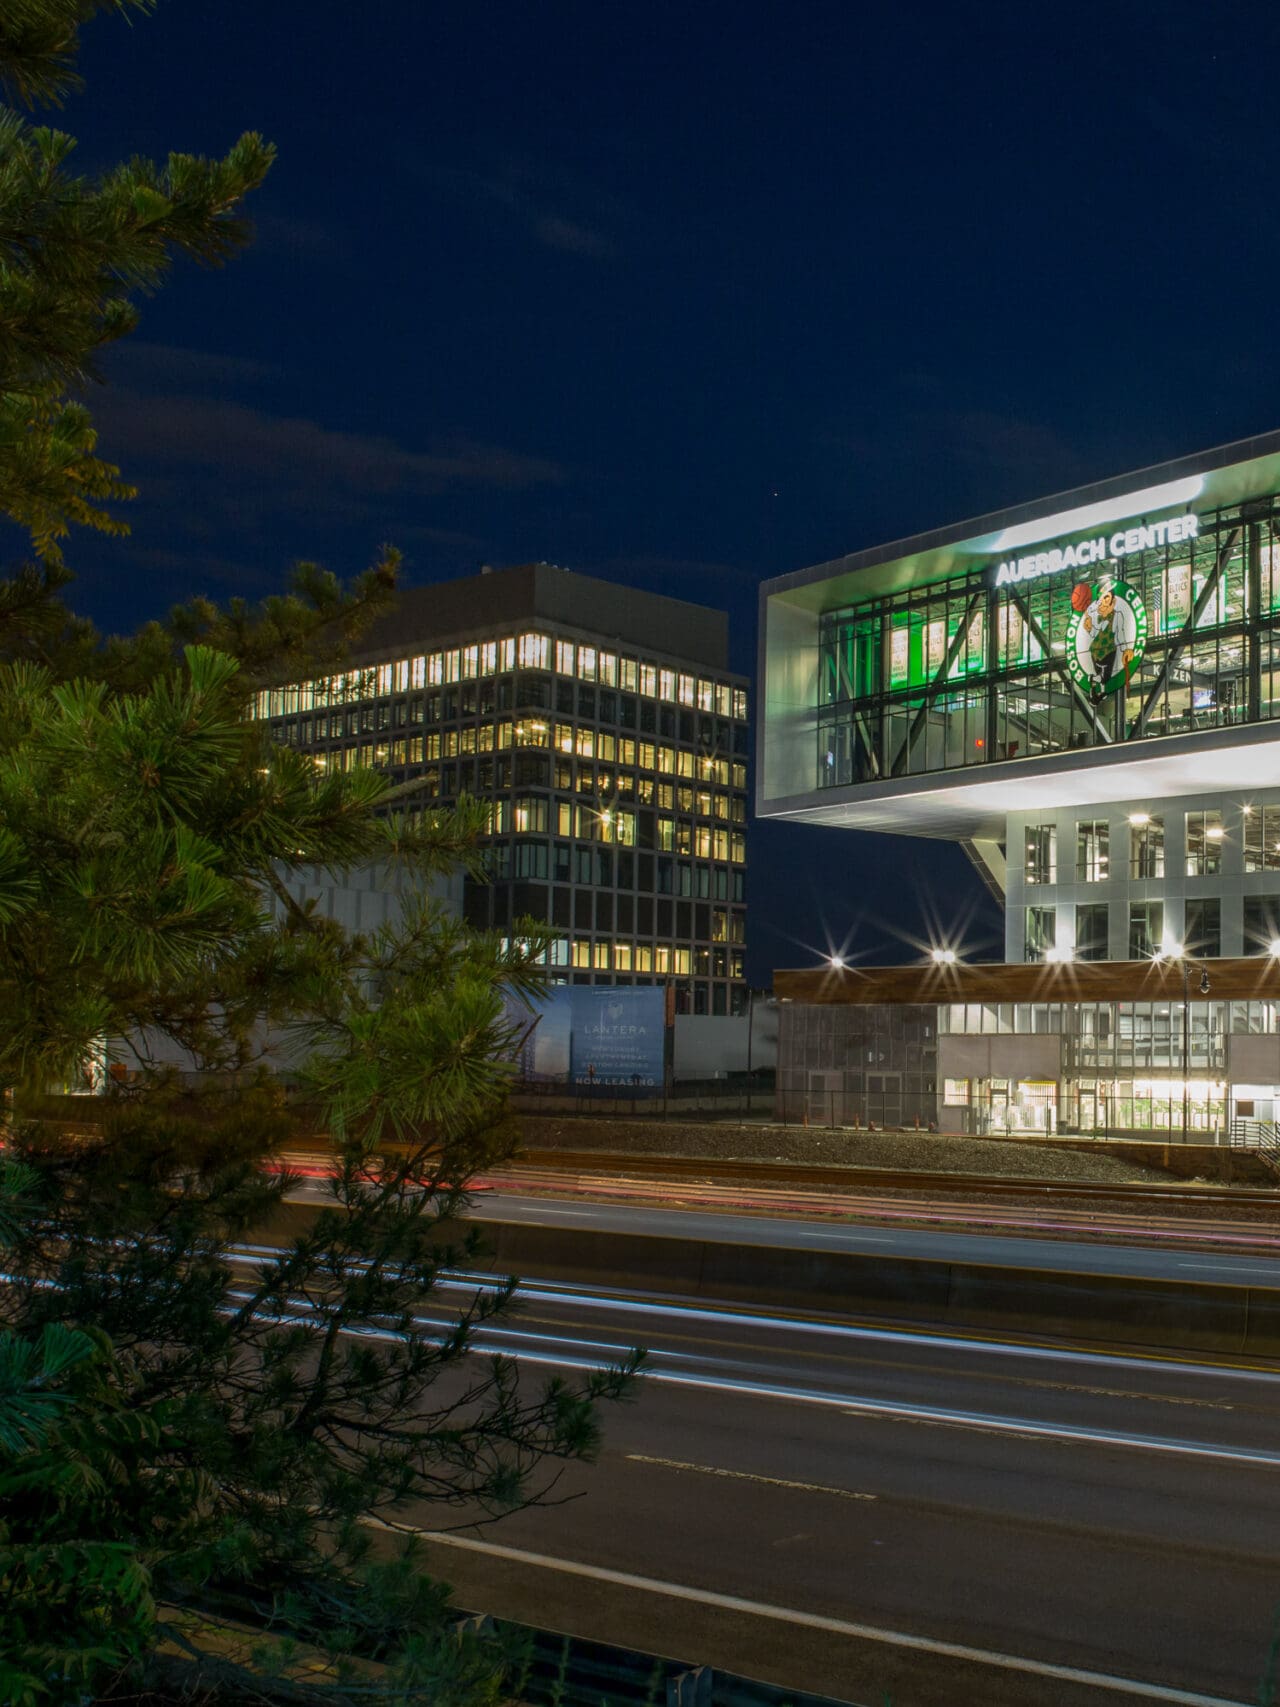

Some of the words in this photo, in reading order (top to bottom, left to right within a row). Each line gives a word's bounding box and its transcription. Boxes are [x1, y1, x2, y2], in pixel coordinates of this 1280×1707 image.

[996, 538, 1105, 586] AUERBACH
[1110, 514, 1198, 556] CENTER
[1125, 588, 1147, 658] CELTICS
[1066, 614, 1084, 682] BOSTON
[1153, 664, 1191, 683] KZEN
[584, 1025, 646, 1035] LANTERA
[575, 1077, 602, 1087] NOW
[604, 1077, 656, 1087] LEASING
